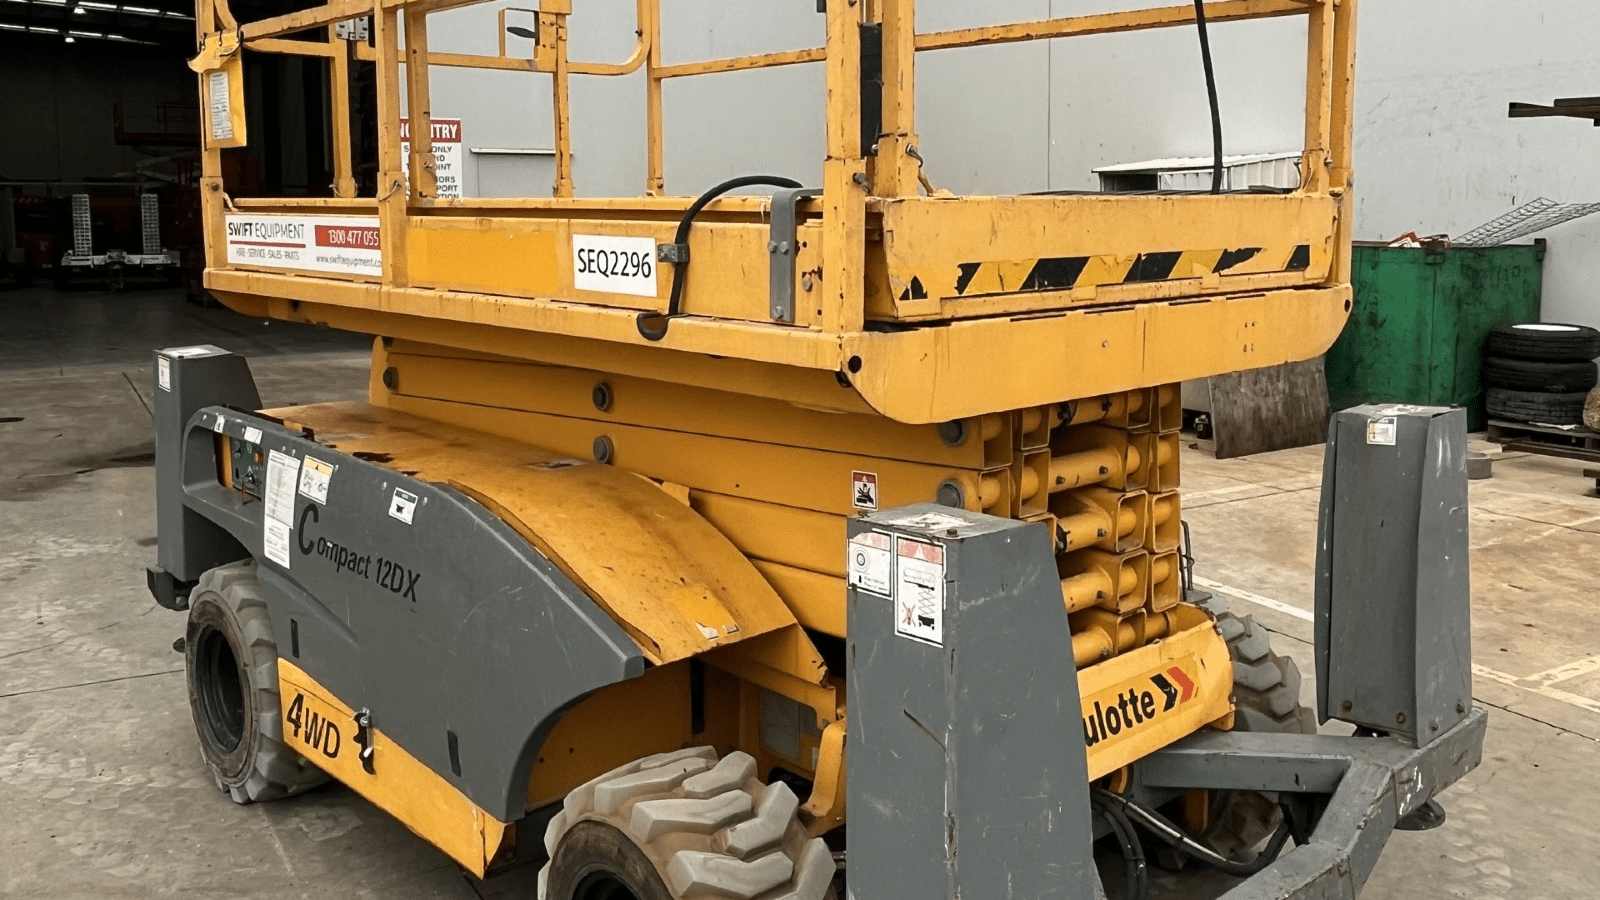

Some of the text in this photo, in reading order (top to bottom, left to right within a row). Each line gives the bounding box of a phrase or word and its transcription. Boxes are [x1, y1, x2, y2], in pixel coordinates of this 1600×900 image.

[430, 124, 458, 139] TRY
[228, 222, 304, 240] SWIFT EQUIPMENT
[328, 229, 379, 246] 1300 477 055
[316, 254, 382, 268] www.swiftequipment.co
[577, 248, 652, 278] SEQ2296
[298, 503, 371, 579] Compact
[376, 557, 421, 603] 12DX
[286, 692, 341, 759] 4WD
[1082, 688, 1156, 747] ulotte
